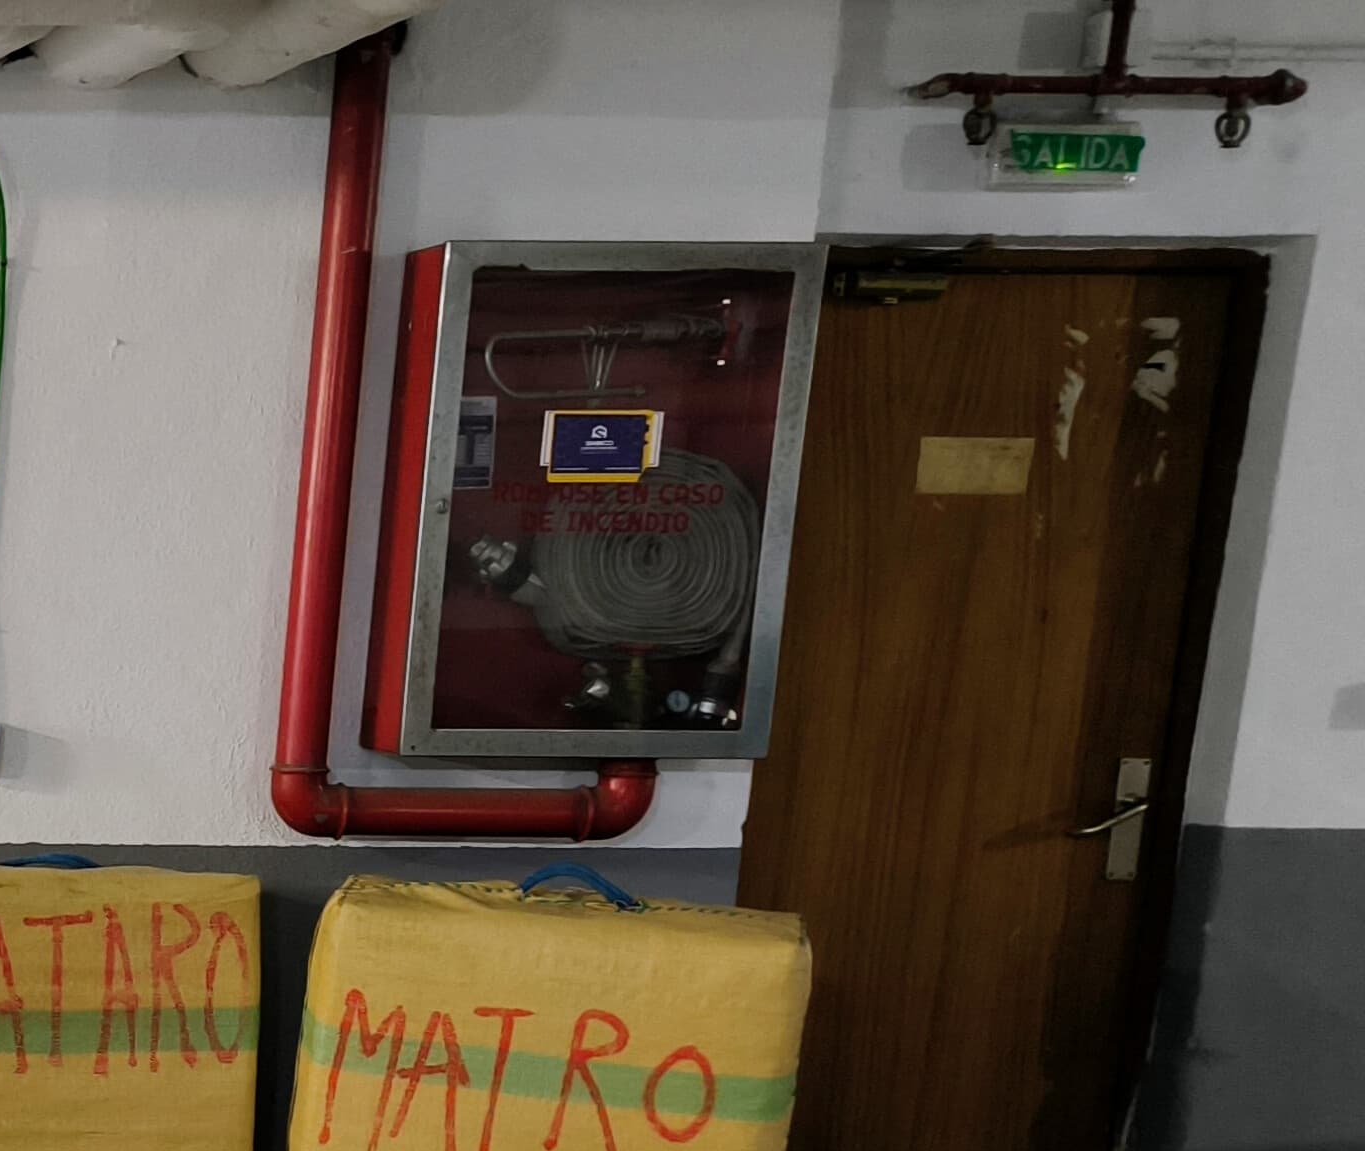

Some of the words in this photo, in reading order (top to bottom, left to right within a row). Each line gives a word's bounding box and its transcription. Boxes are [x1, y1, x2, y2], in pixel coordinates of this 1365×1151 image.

[1013, 135, 1130, 170] SALIDA
[616, 483, 649, 505] EN
[658, 483, 725, 506] CASO
[522, 511, 554, 533] DE
[565, 511, 690, 533] INCENDIO
